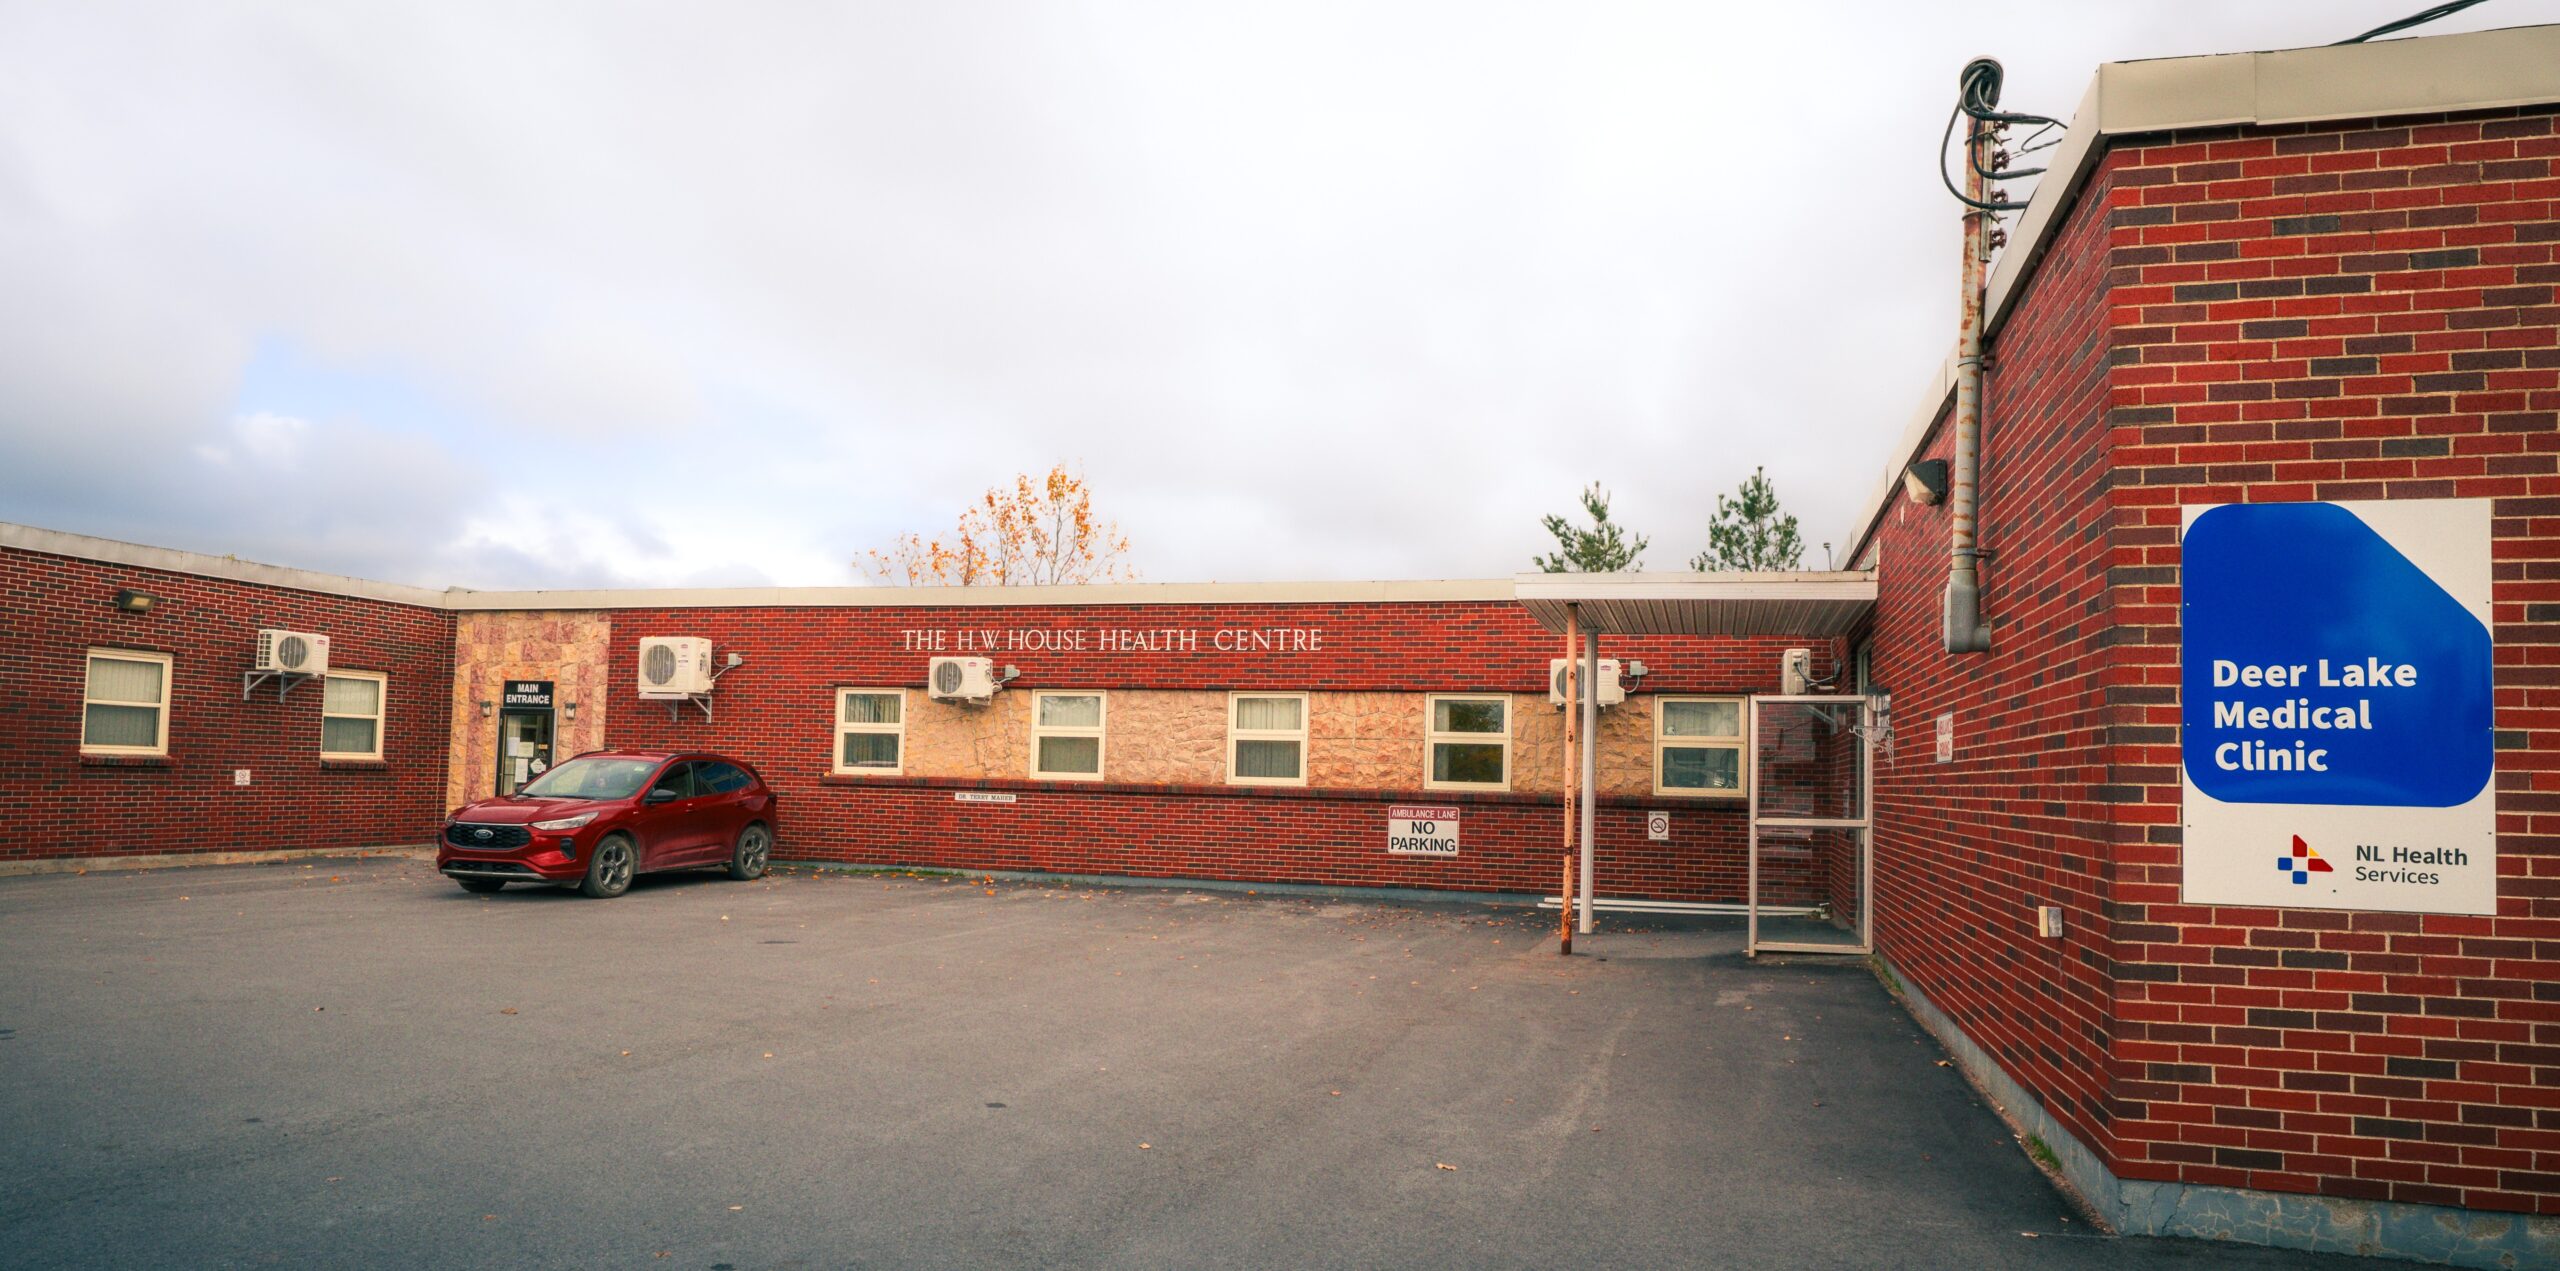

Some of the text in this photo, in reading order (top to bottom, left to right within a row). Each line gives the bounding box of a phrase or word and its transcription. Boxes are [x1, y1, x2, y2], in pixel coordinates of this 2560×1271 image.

[901, 629, 946, 651] THE
[1008, 629, 1087, 651] HOUSE
[1100, 629, 1197, 651] HEALTH
[1214, 628, 1322, 651] CENTRE
[2213, 656, 2418, 688] Deer Lake
[517, 684, 539, 693] MAIN
[506, 694, 550, 704] ENTRANCE
[2214, 697, 2373, 730] Medical
[2215, 739, 2329, 772] Clinic
[1391, 809, 1457, 819] AMBULANCE LANE
[1411, 821, 1435, 835] NO
[1390, 837, 1456, 852] PARKING
[2356, 845, 2468, 866] NL Health
[2355, 866, 2439, 885] Services
